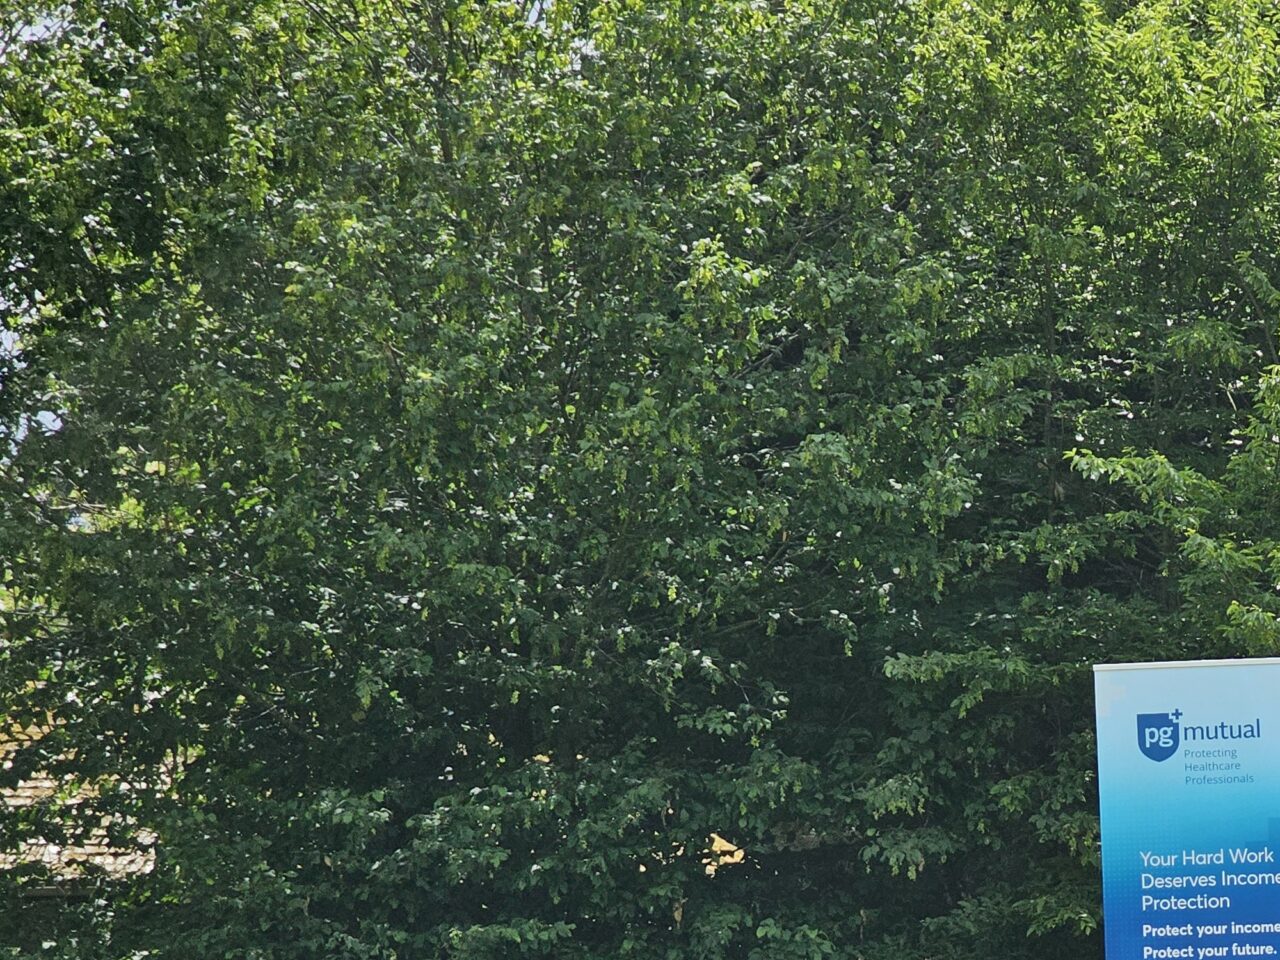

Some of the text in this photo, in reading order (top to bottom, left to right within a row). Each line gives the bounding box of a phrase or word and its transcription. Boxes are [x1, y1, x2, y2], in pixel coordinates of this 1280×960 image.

[1144, 718, 1261, 748] pg mutual
[1184, 748, 1238, 759] Protecting
[1184, 761, 1241, 772] Healthcare
[1185, 774, 1254, 785] Professionals
[1140, 847, 1274, 867] Your Hard Work
[1141, 873, 1217, 889] Deserves
[1142, 894, 1230, 911] Protection
[1142, 924, 1193, 937] Protect
[1197, 925, 1228, 938] your
[1143, 943, 1278, 960] Protect your future.
